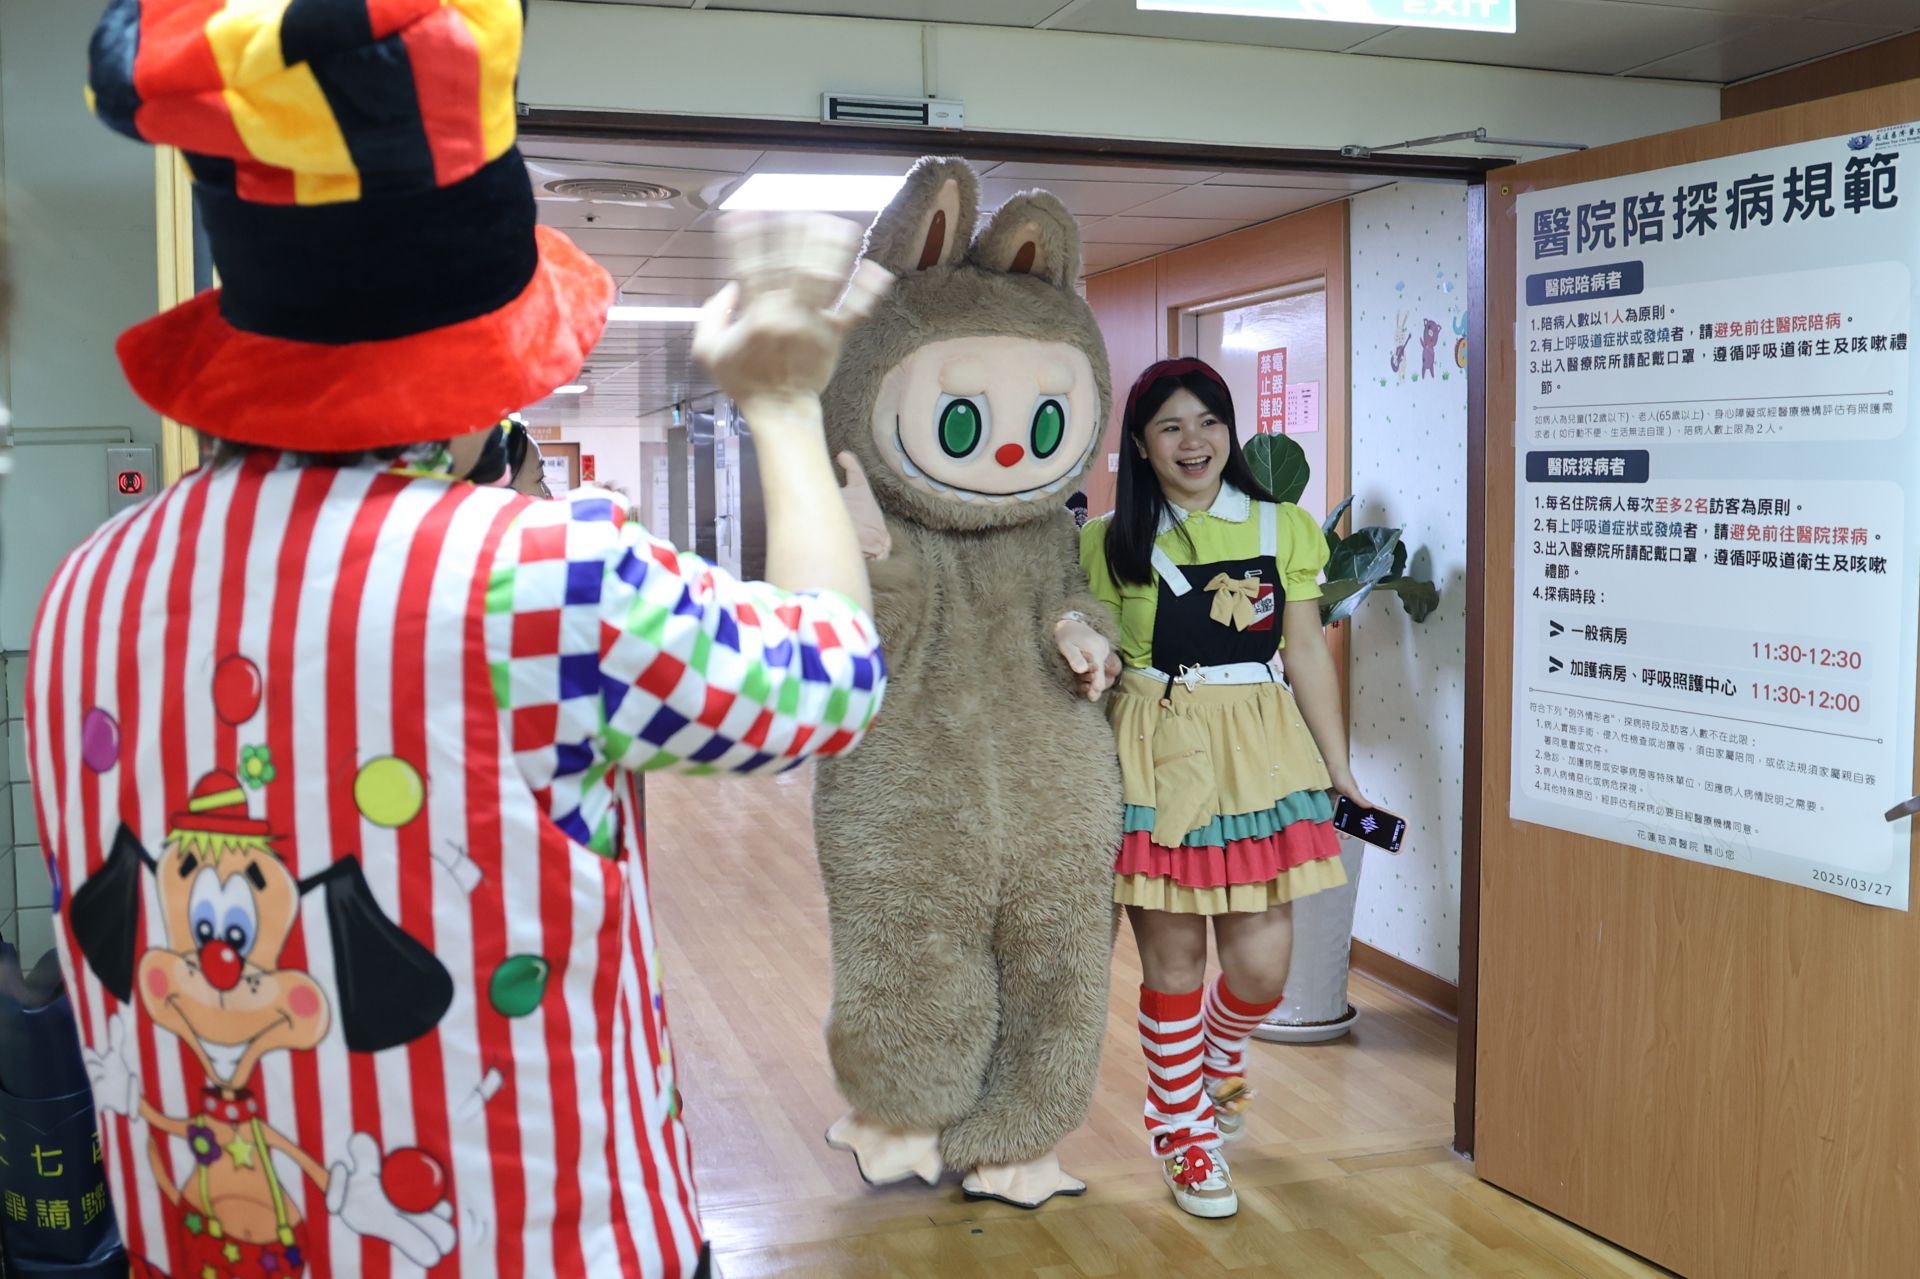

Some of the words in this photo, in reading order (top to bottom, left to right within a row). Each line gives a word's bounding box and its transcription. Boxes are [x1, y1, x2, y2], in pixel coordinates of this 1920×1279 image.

[1403, 0, 1501, 18] EXIT
[1533, 152, 1900, 260] 醫院陪探病規範
[1545, 271, 1622, 298] 醫院陪病者
[1260, 354, 1271, 434] 禁止進入
[1272, 352, 1283, 433] 電器設備
[1541, 380, 1561, 395] 節。
[1547, 457, 1626, 477] 醫院探病者
[1544, 564, 1579, 580] 禮節。
[1571, 625, 1628, 645] 一般病房
[1752, 641, 1862, 670] 11:30-12:30
[1570, 659, 1737, 696] 加護病房、呼吸照護中心
[1752, 683, 1860, 713] 11:30-12:00
[1812, 869, 1893, 897] 2025/03/27
